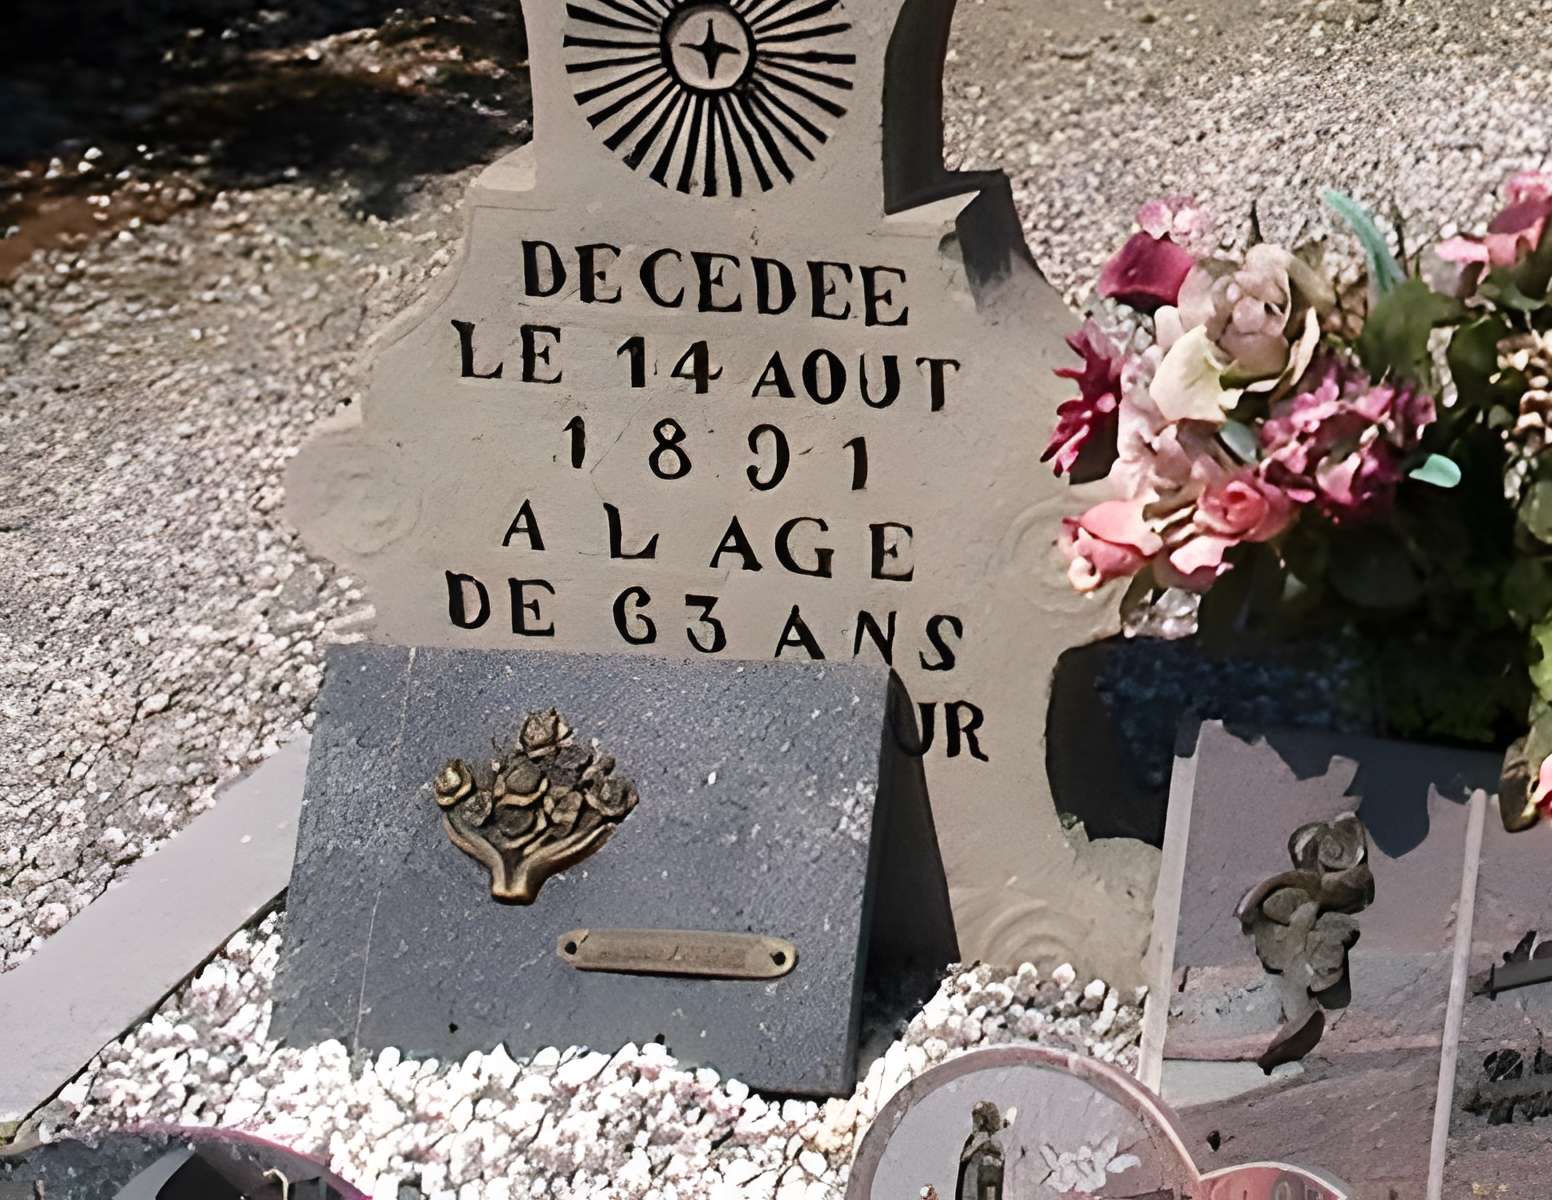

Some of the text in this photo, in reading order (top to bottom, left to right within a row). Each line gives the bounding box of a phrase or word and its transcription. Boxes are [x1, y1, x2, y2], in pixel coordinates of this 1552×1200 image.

[522, 240, 908, 327] DECEDEE
[451, 320, 960, 412] LE 14 AOUT
[445, 570, 963, 671] DE 63 ANS
